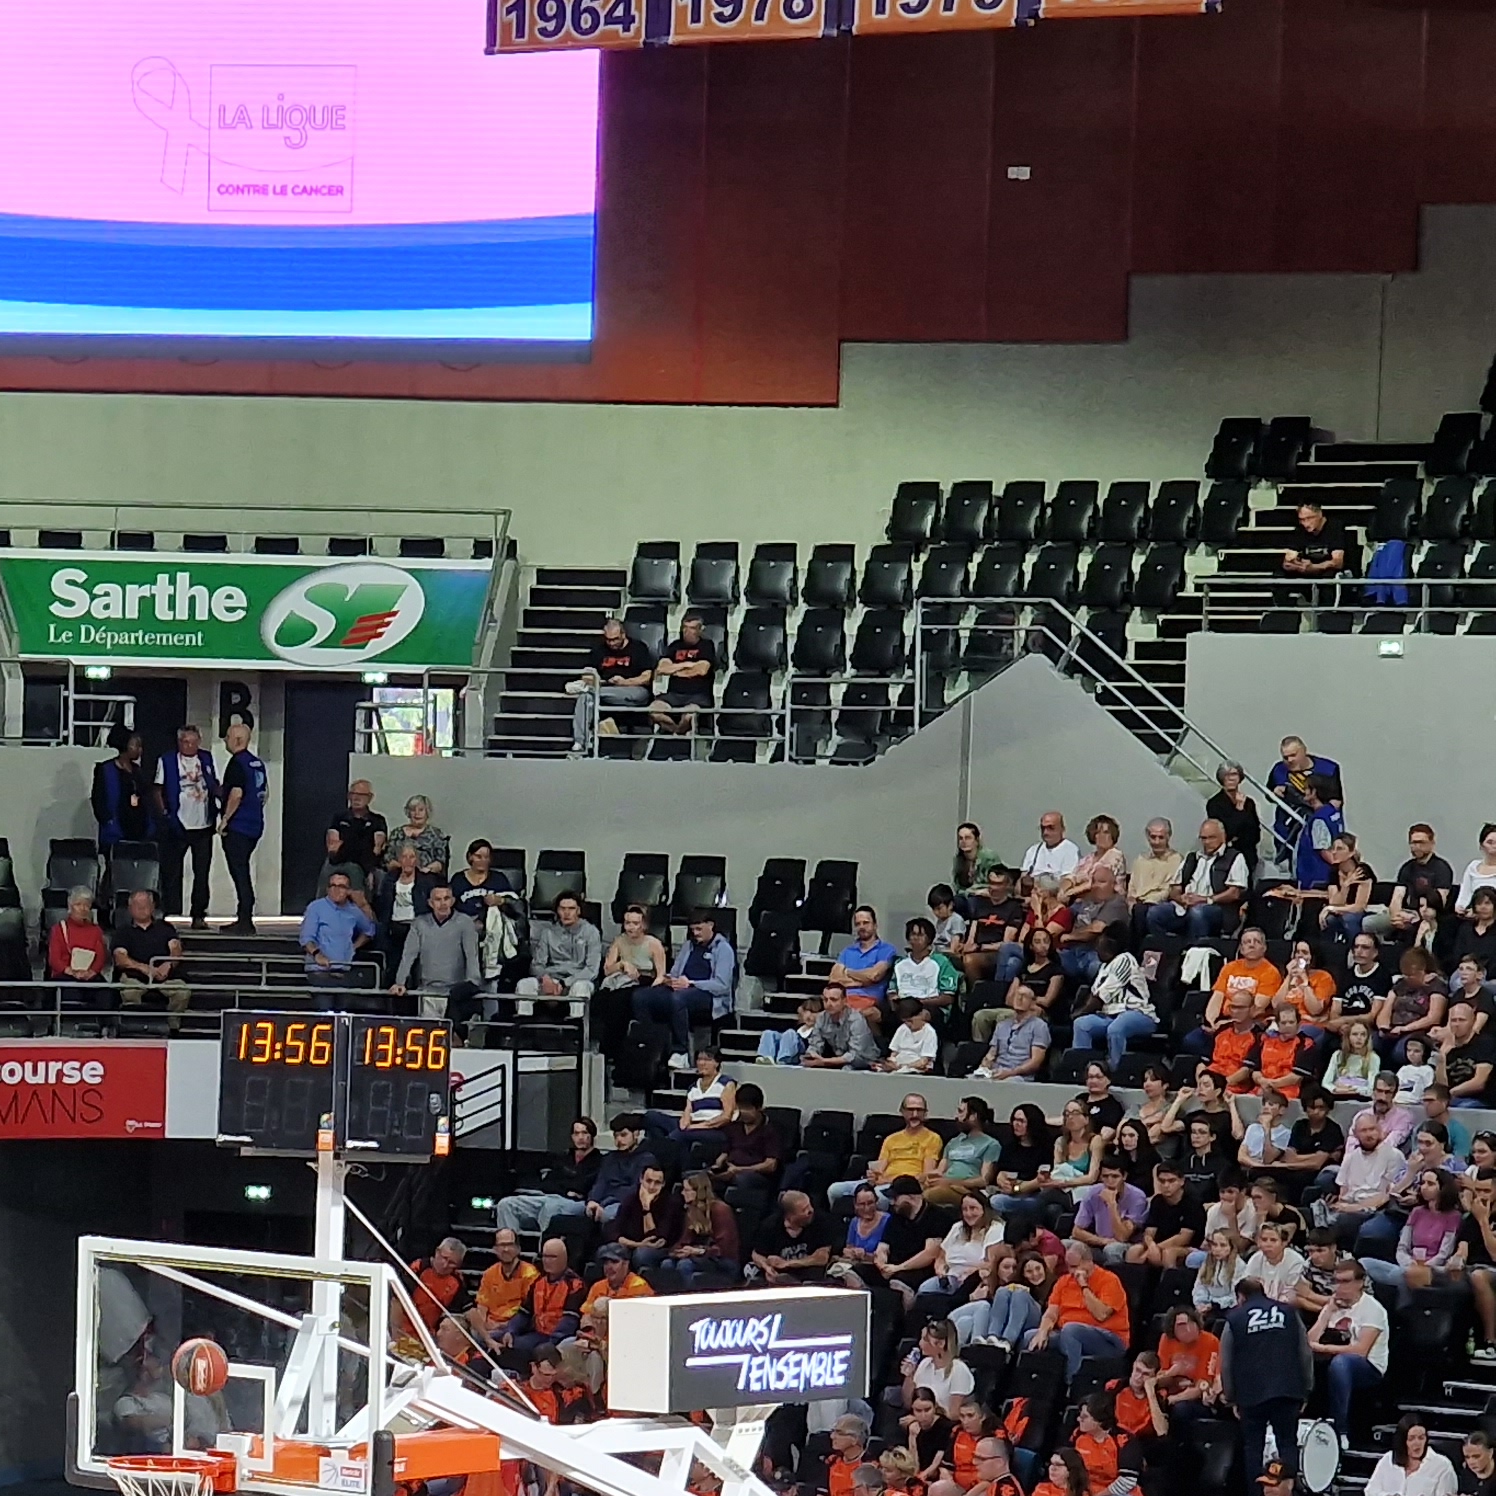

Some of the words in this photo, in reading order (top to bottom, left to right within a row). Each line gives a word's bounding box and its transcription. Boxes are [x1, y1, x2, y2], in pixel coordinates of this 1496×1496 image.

[218, 103, 253, 129] LA
[217, 184, 269, 196] CONTRE
[272, 184, 288, 196] LE
[291, 184, 344, 196] CANCER
[48, 567, 248, 622] Sarthe
[48, 623, 73, 643] Le
[79, 623, 204, 649] Département
[238, 1021, 333, 1066] 13:56
[362, 1025, 448, 1071] 13:56
[750, 1350, 851, 1392] ENSEMBLE
